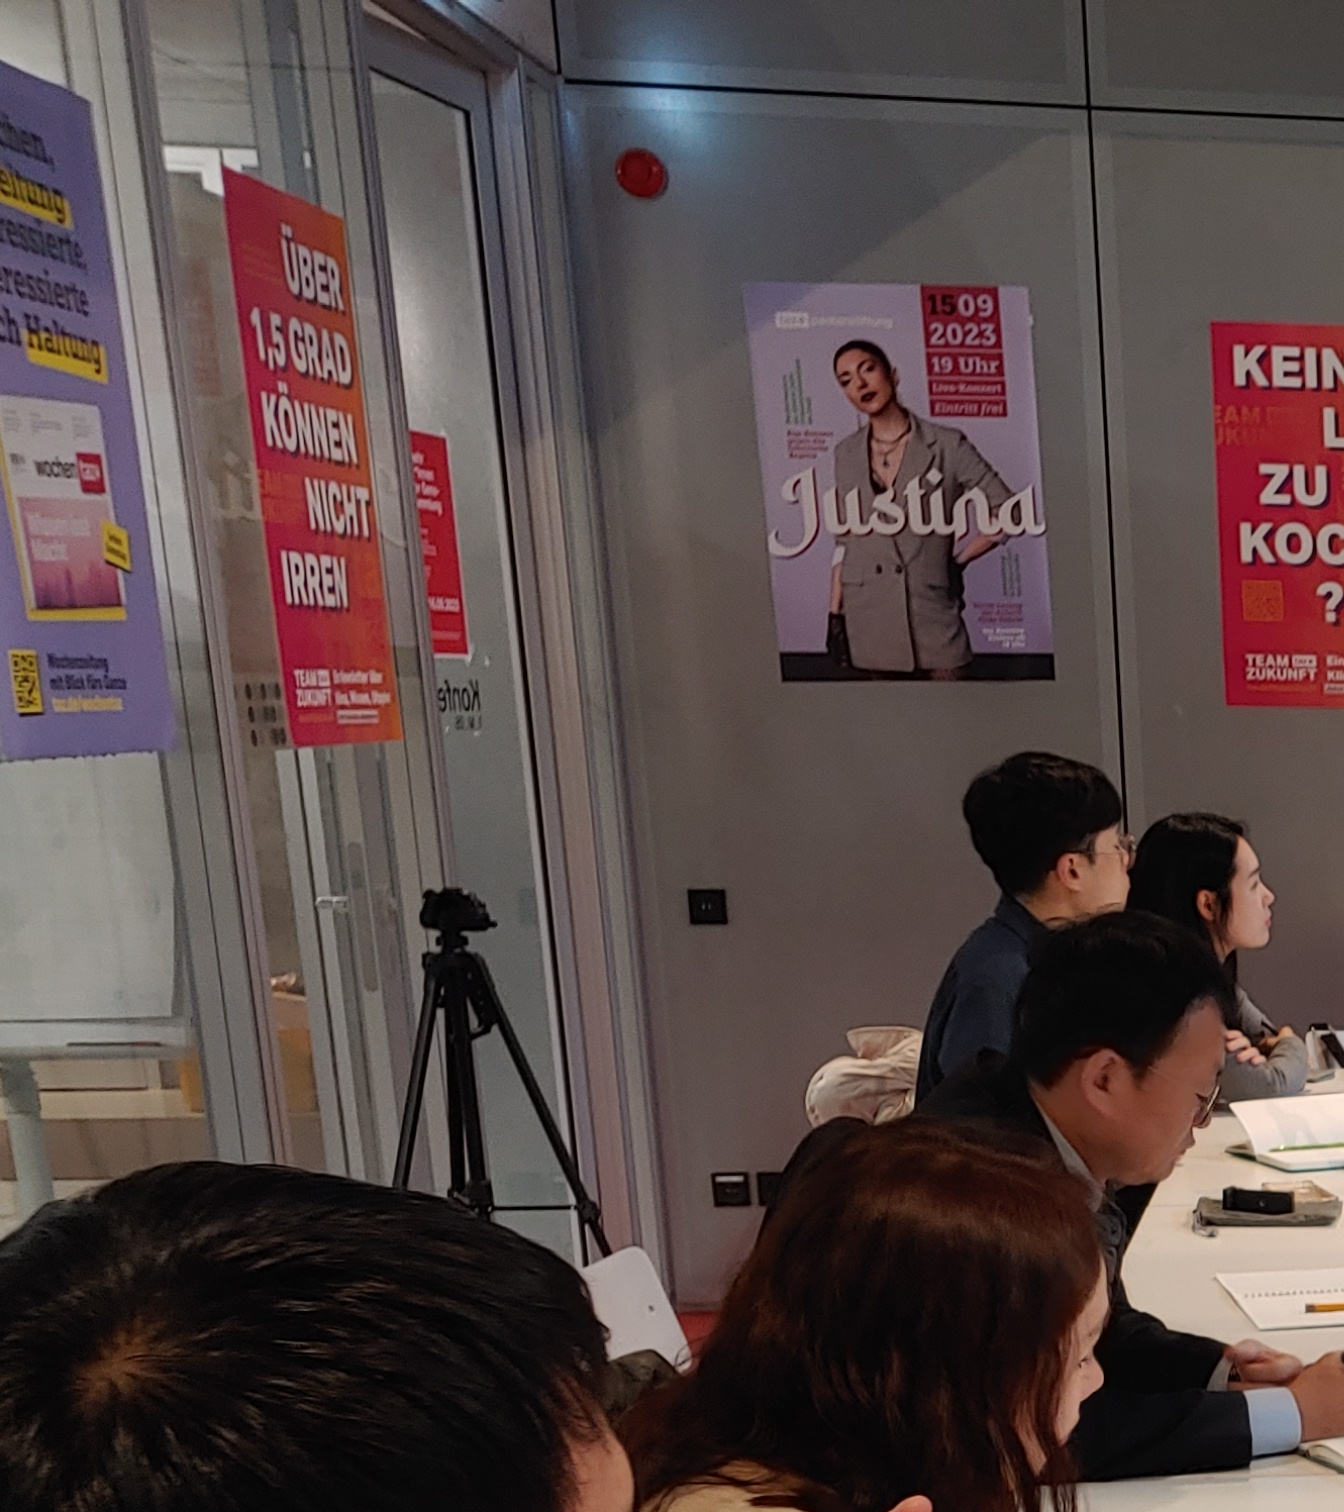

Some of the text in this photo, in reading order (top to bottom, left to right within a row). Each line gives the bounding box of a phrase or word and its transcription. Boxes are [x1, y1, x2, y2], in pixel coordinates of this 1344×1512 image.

[0, 163, 67, 224] eitung
[0, 217, 88, 273] ressierte,
[280, 222, 345, 312] ÜBER
[0, 264, 90, 317] eressierte
[23, 311, 102, 375] Haltung
[250, 306, 352, 387] 1,5 GRAD
[929, 322, 997, 346] 2023
[931, 356, 1000, 374] 19 Uhr
[260, 381, 359, 466] KÖNNEN
[934, 401, 1004, 416] Eintritt frei
[304, 476, 370, 538] NICHT
[1258, 462, 1329, 507] ZU
[768, 466, 1047, 559] Justina
[280, 549, 349, 609] IRREN
[294, 669, 317, 687] TEAM
[1245, 653, 1289, 668] TEAM
[1246, 667, 1317, 682] ZUKUNFT
[1326, 655, 1344, 667] Ein
